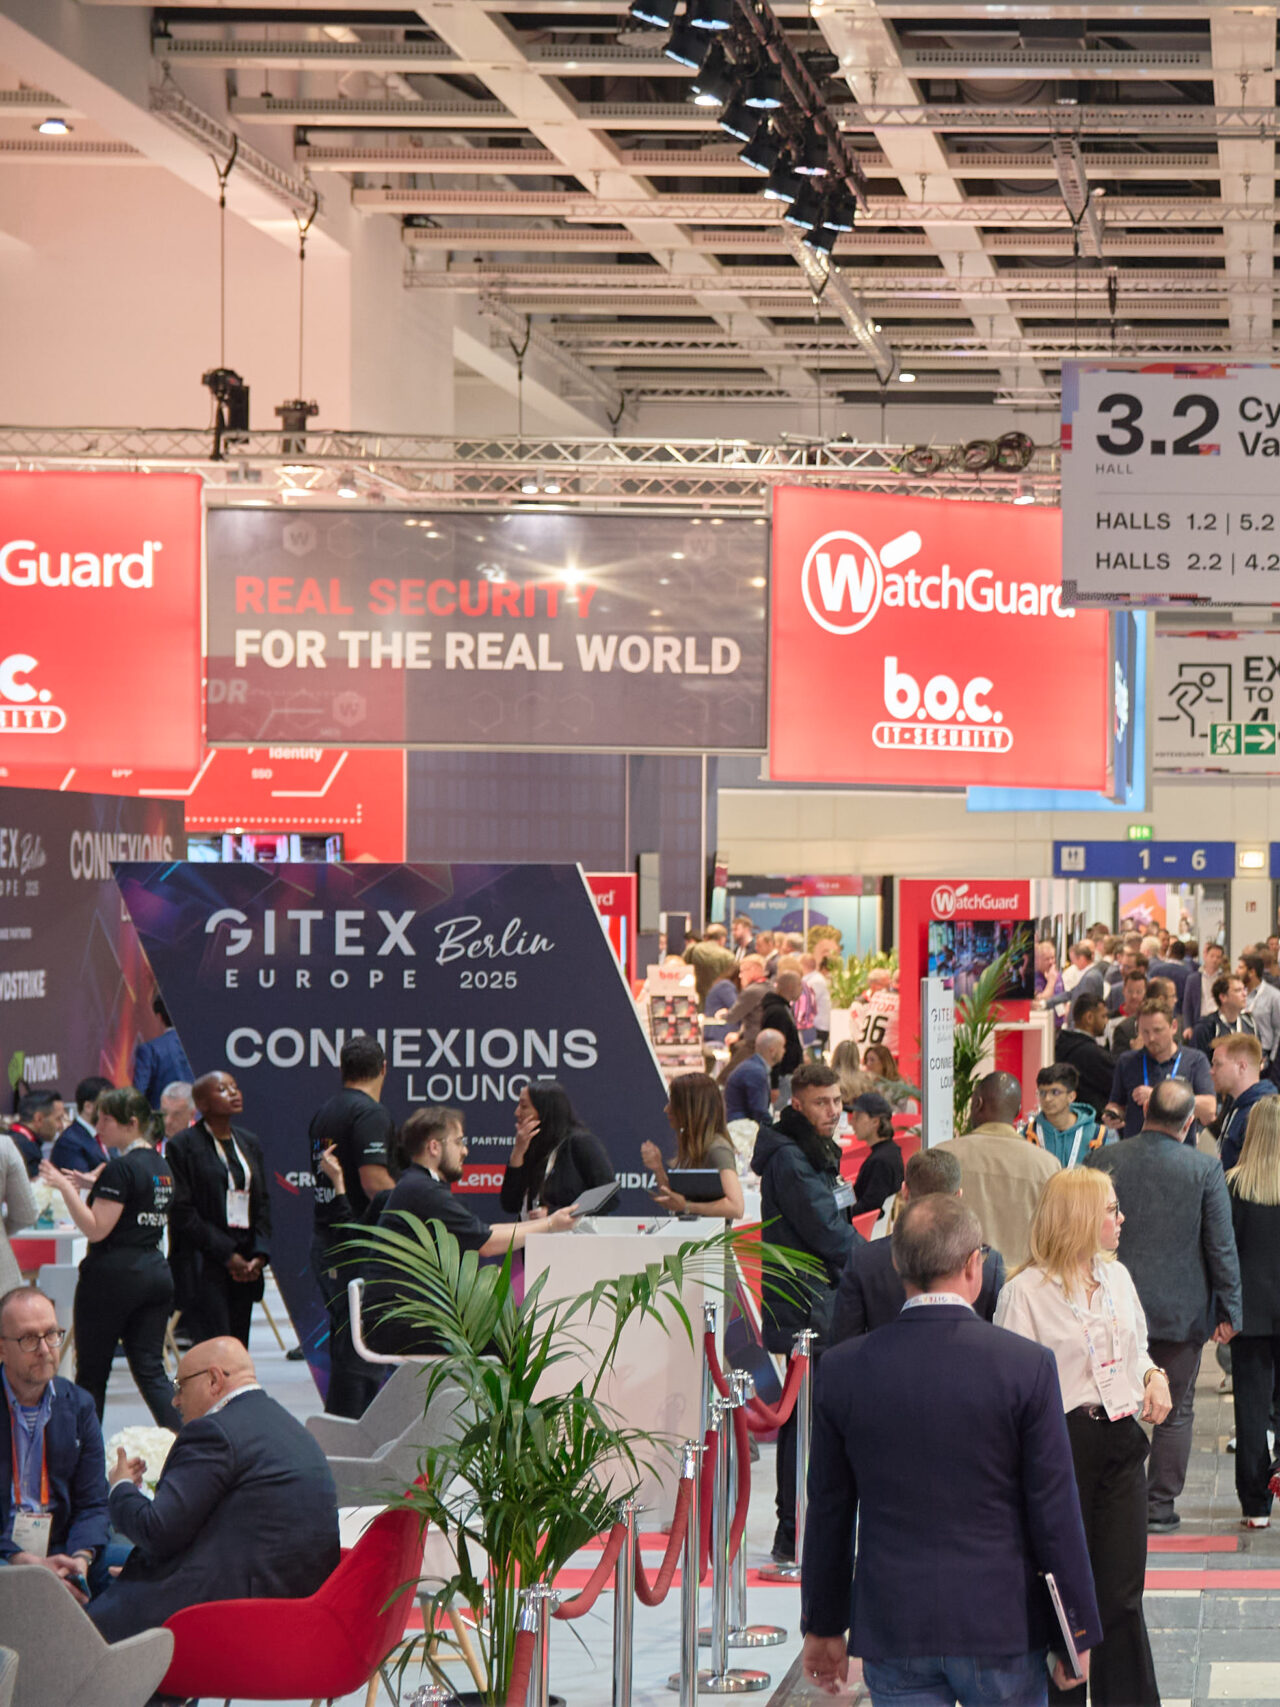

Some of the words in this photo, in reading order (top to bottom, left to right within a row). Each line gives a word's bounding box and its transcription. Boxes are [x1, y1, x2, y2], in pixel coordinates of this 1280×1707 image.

[1096, 393, 1220, 456] 3.2
[1096, 463, 1133, 475] HALL
[1096, 512, 1171, 530] HALLS
[1187, 514, 1217, 531] 1.2
[1240, 514, 1275, 531] 5.2
[0, 540, 153, 588] Guard
[1096, 552, 1171, 570] HALLS
[1187, 553, 1222, 570] 2.2
[1245, 554, 1280, 571] 4.2
[235, 577, 354, 615] REAL
[369, 578, 597, 618] SECURITY
[235, 629, 326, 668] FOR
[339, 631, 432, 669] THE
[446, 632, 563, 671] REAL
[576, 635, 741, 675] WORLD
[884, 656, 1003, 723] b.o.c.
[1244, 686, 1273, 703] TO
[269, 746, 323, 763] Identity
[1139, 849, 1149, 870] 1
[1191, 849, 1206, 870] 6
[205, 908, 416, 957] GITEX
[434, 916, 555, 966] Berlin
[226, 970, 416, 988] EUROPE
[460, 971, 518, 989] 2025
[458, 1173, 504, 1187] Leno
